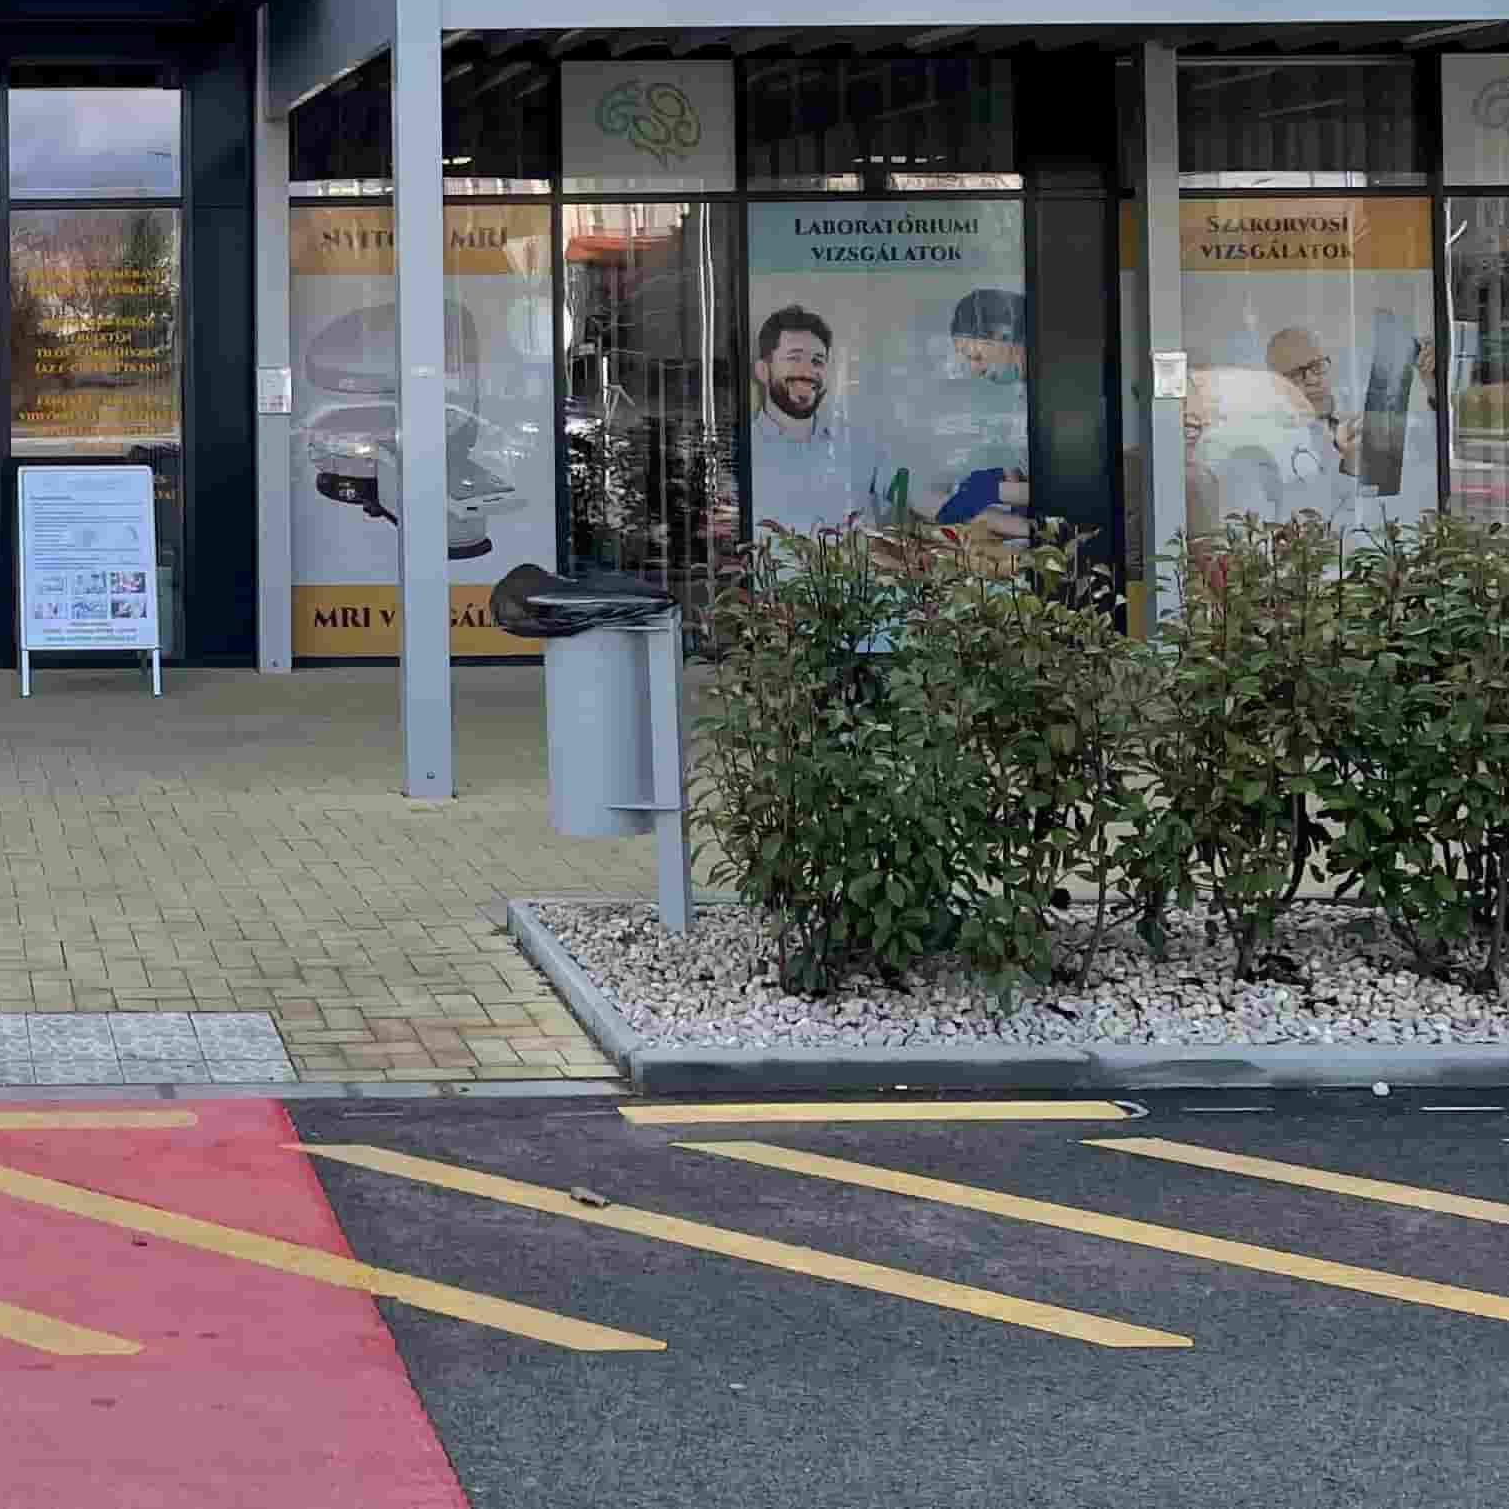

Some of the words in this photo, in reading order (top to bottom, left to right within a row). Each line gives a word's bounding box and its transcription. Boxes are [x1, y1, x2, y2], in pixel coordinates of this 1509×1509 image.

[794, 211, 979, 236] LABORATÓRIUMI
[1205, 215, 1349, 234] SZAKORVOSI
[810, 242, 963, 262] VIZSGÁLATOK
[314, 606, 371, 628] MRI
